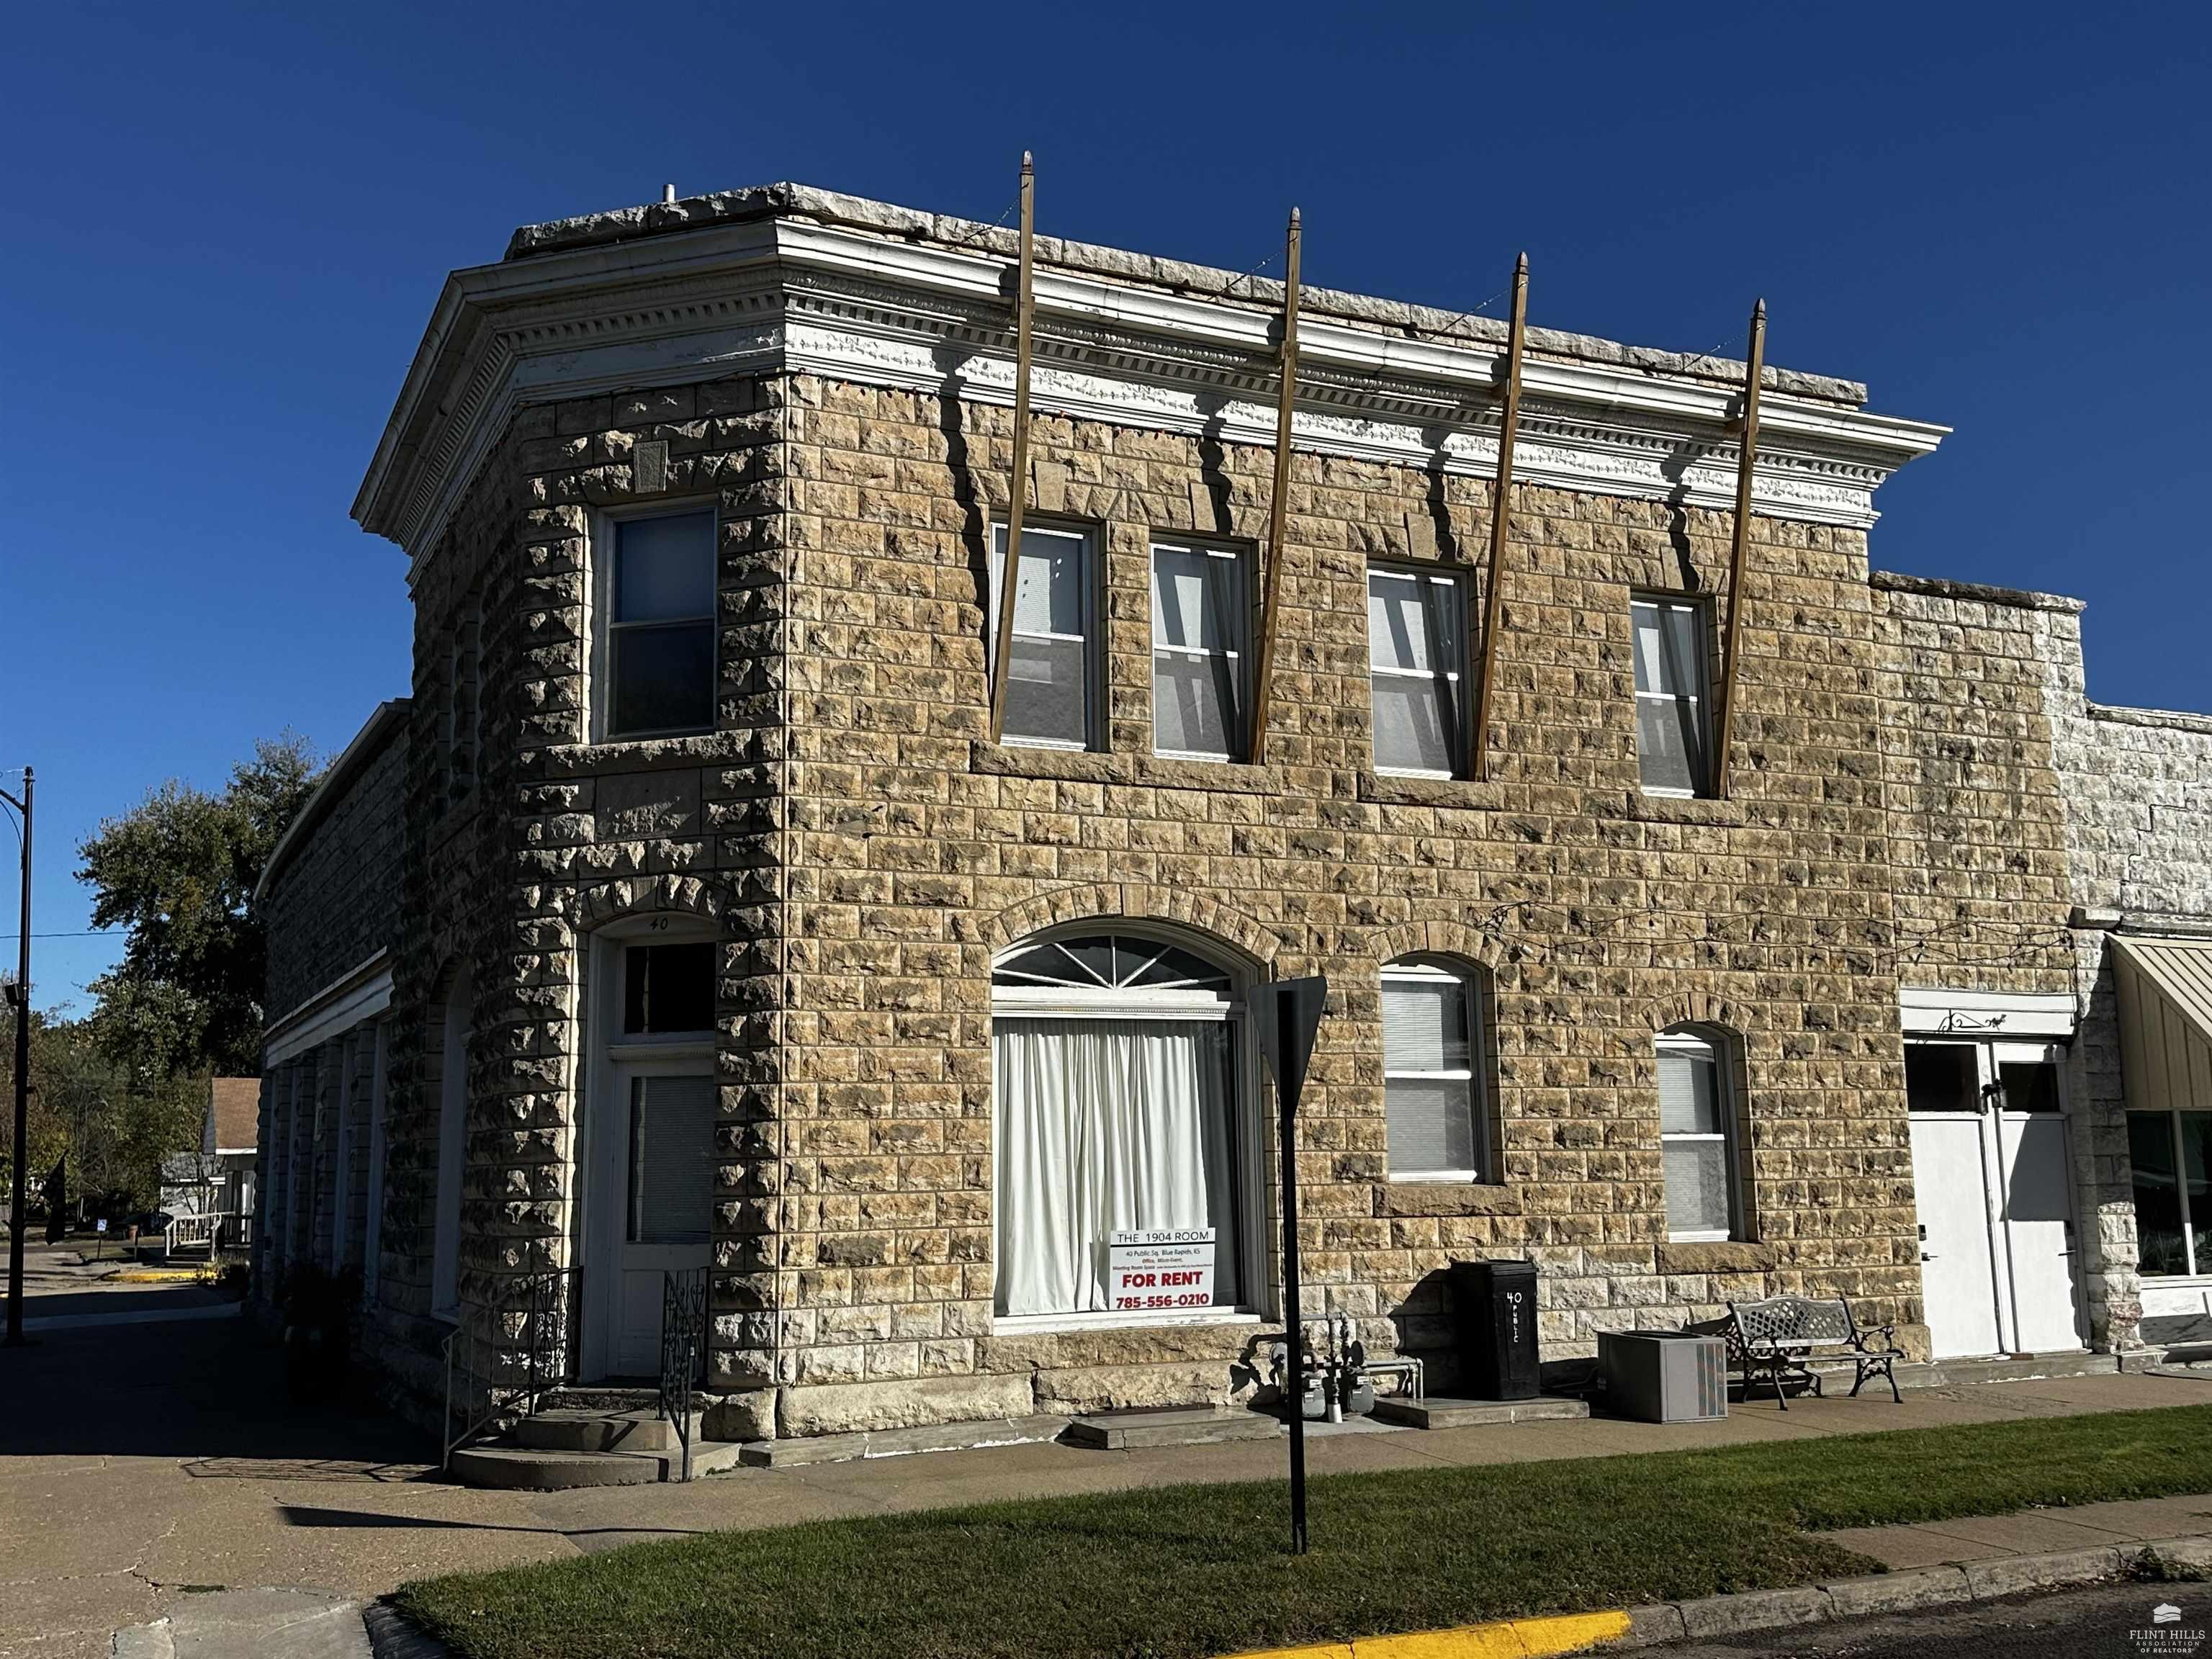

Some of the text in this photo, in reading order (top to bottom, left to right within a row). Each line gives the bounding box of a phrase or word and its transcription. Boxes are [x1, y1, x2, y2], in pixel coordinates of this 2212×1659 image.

[649, 917, 668, 930] 40
[1118, 1231, 1209, 1243] THE 1904 ROOM
[1123, 1271, 1203, 1288] FOR RENT
[1116, 1293, 1210, 1309] 785-556-0210
[1506, 1292, 1522, 1303] 40
